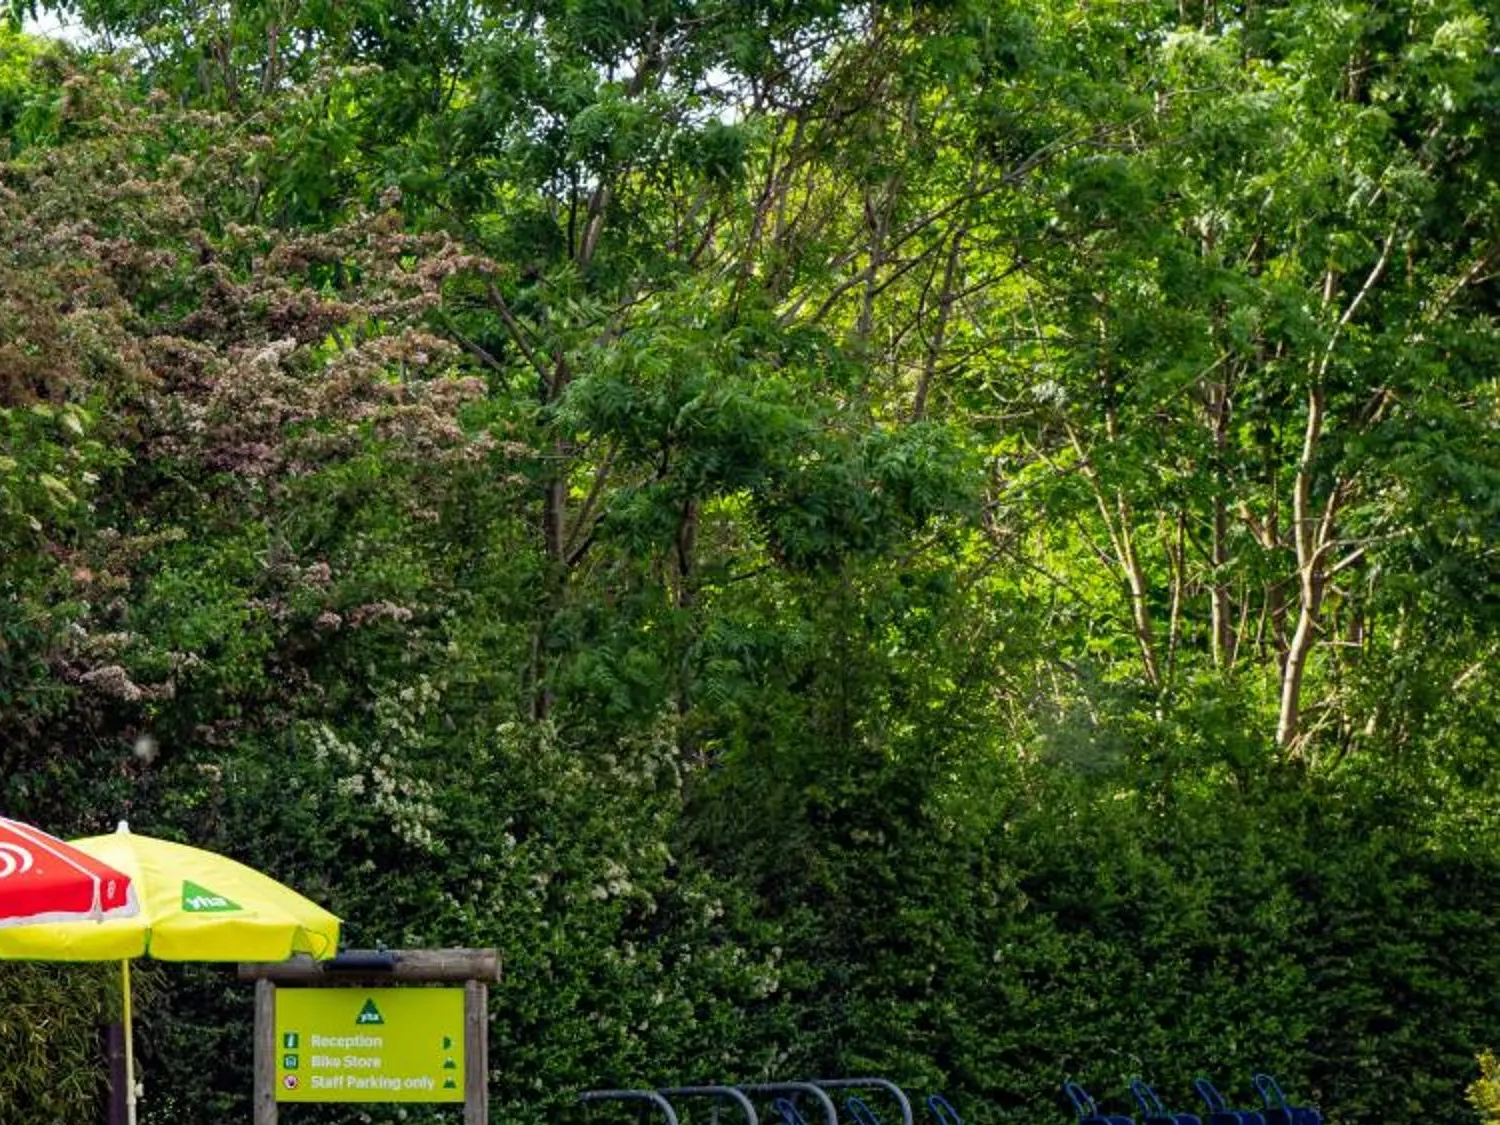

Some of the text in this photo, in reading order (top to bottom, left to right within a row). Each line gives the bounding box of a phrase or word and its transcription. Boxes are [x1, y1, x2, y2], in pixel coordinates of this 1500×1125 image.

[185, 896, 228, 909] yha
[311, 1034, 382, 1049] Reception
[311, 1055, 381, 1068] Bike Store
[311, 1075, 435, 1091] Staff Parking only
